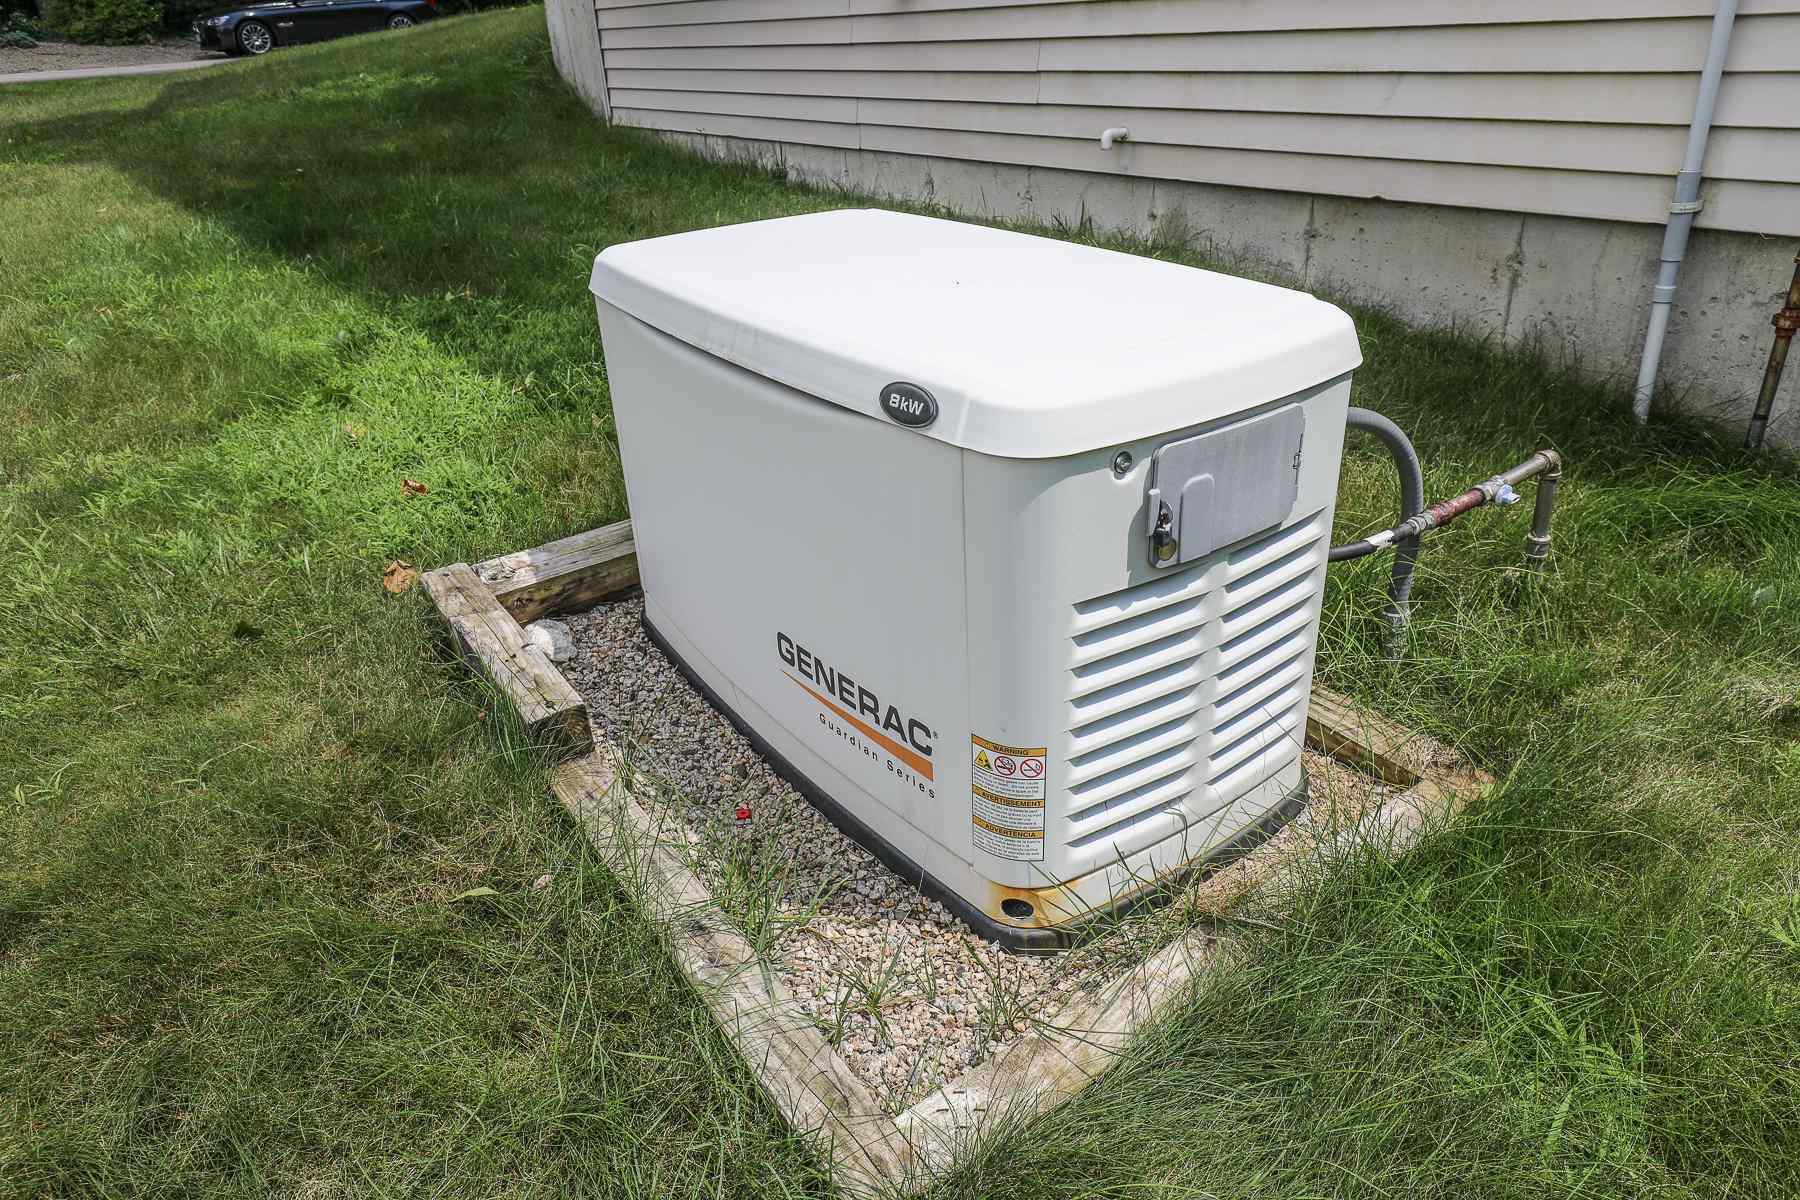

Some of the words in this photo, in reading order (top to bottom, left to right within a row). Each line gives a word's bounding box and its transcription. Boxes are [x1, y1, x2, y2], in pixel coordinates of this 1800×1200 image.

[890, 393, 924, 415] 8kW
[777, 632, 933, 756] GENERAC
[819, 713, 878, 761] Guardian
[886, 759, 936, 799] Series
[992, 744, 1029, 755] WARNING
[985, 823, 1036, 838] ADVERTENCIA
